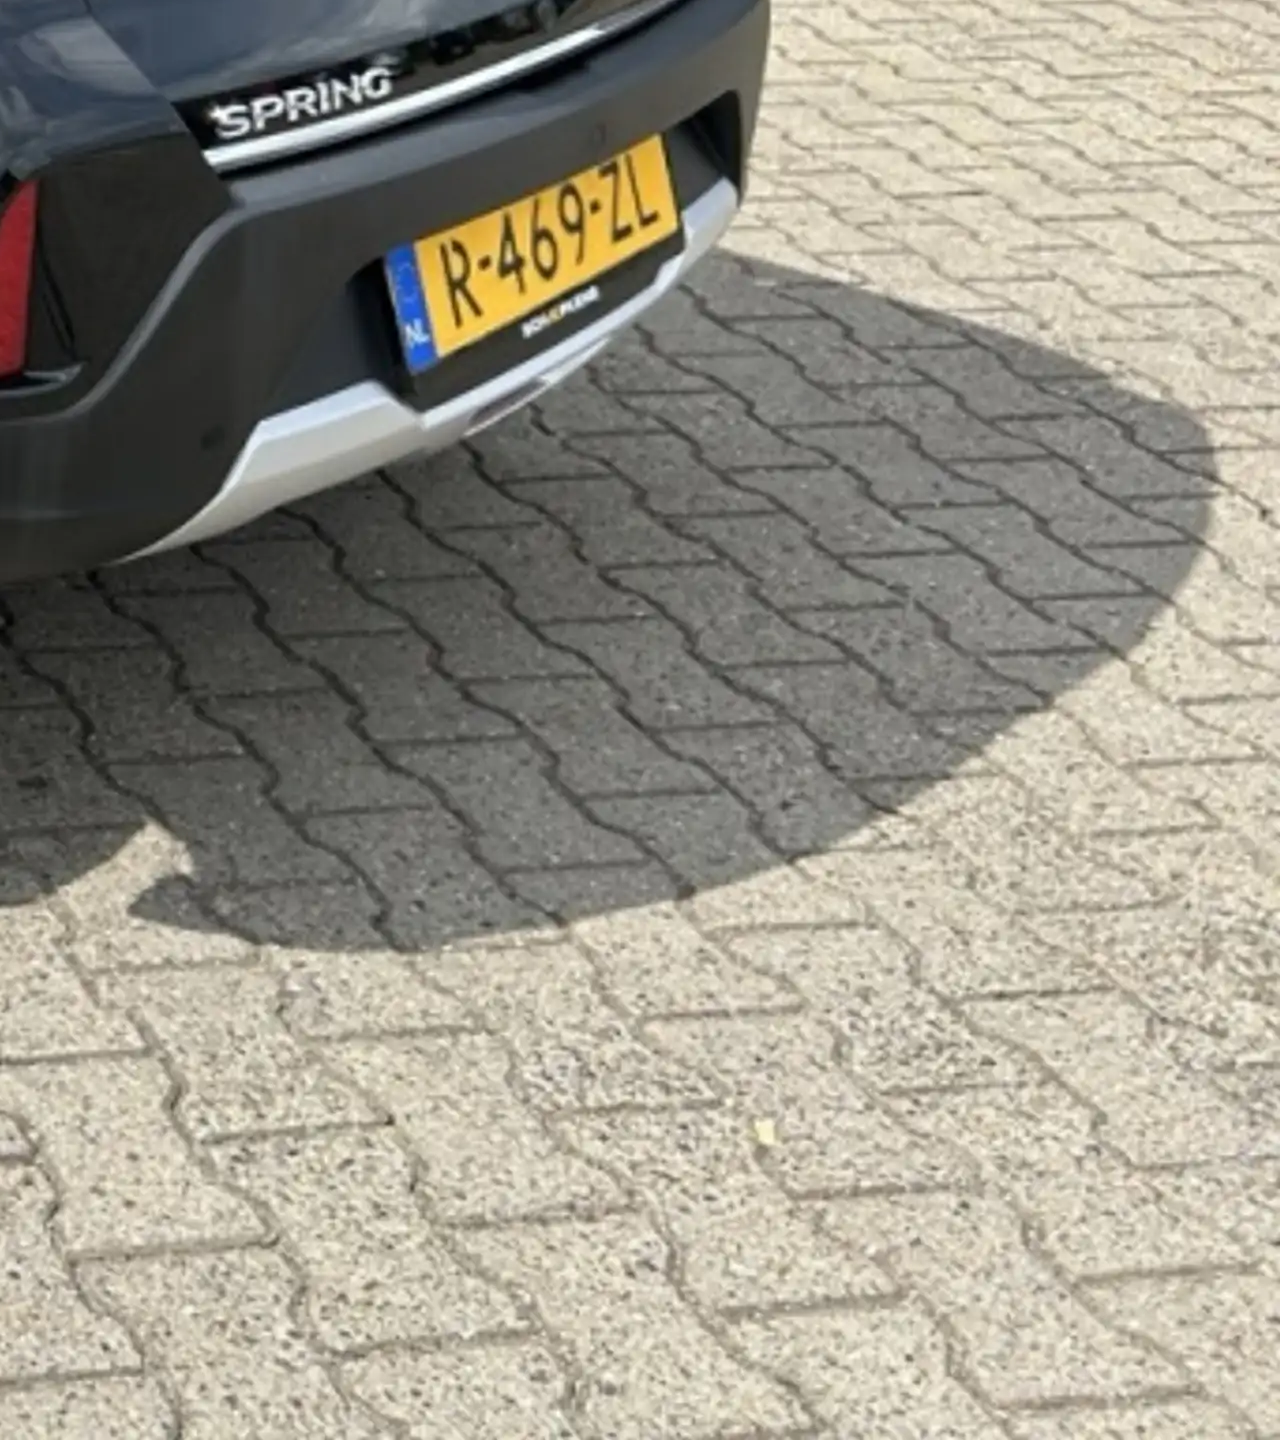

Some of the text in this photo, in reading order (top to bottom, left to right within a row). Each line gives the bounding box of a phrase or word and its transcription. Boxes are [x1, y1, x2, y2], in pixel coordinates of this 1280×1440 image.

[212, 66, 393, 140] SPRING
[439, 154, 660, 328] R-469-ZL
[404, 317, 430, 347] NL
